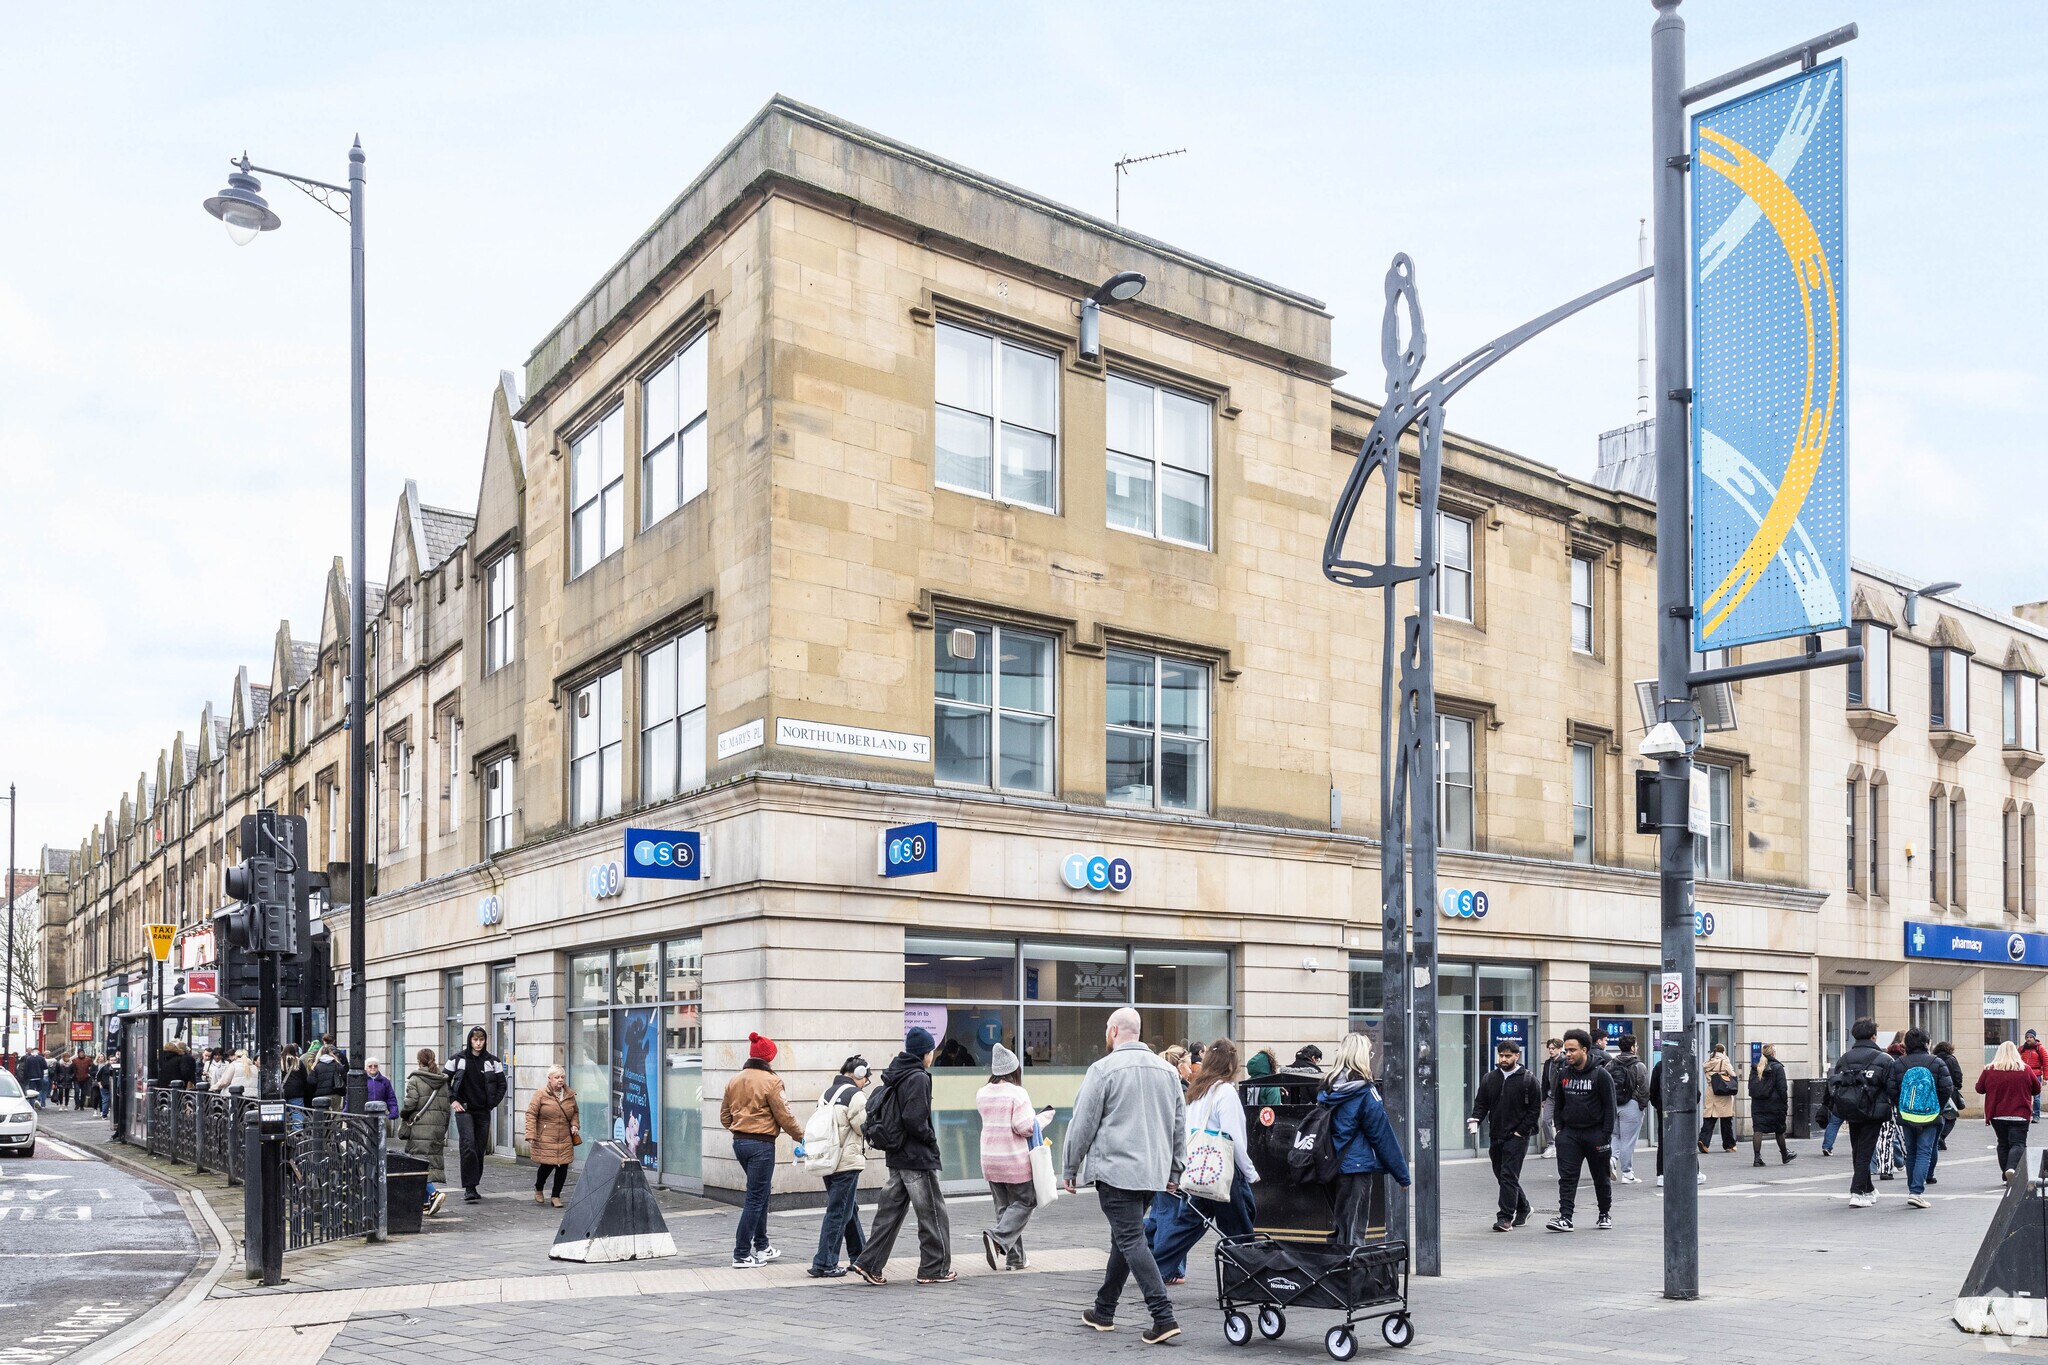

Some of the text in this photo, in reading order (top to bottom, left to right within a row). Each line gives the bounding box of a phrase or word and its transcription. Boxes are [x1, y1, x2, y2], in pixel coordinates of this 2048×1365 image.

[729, 730, 751, 748] MARY'S
[782, 725, 927, 755] NORTHUMBERLAND ST.
[638, 843, 691, 864] TSB
[890, 837, 924, 862] TSB
[590, 865, 617, 893] TSB
[1069, 858, 1130, 886] TSB
[478, 899, 498, 921] TSB
[1444, 890, 1487, 916] TSB
[1695, 914, 1714, 933] SB
[1951, 936, 1982, 953] pharmacy
[1987, 995, 2005, 1005] dispense
[1984, 1008, 2005, 1016] escriptions
[1501, 1023, 1518, 1033] TSB
[1608, 1025, 1624, 1034] TSB
